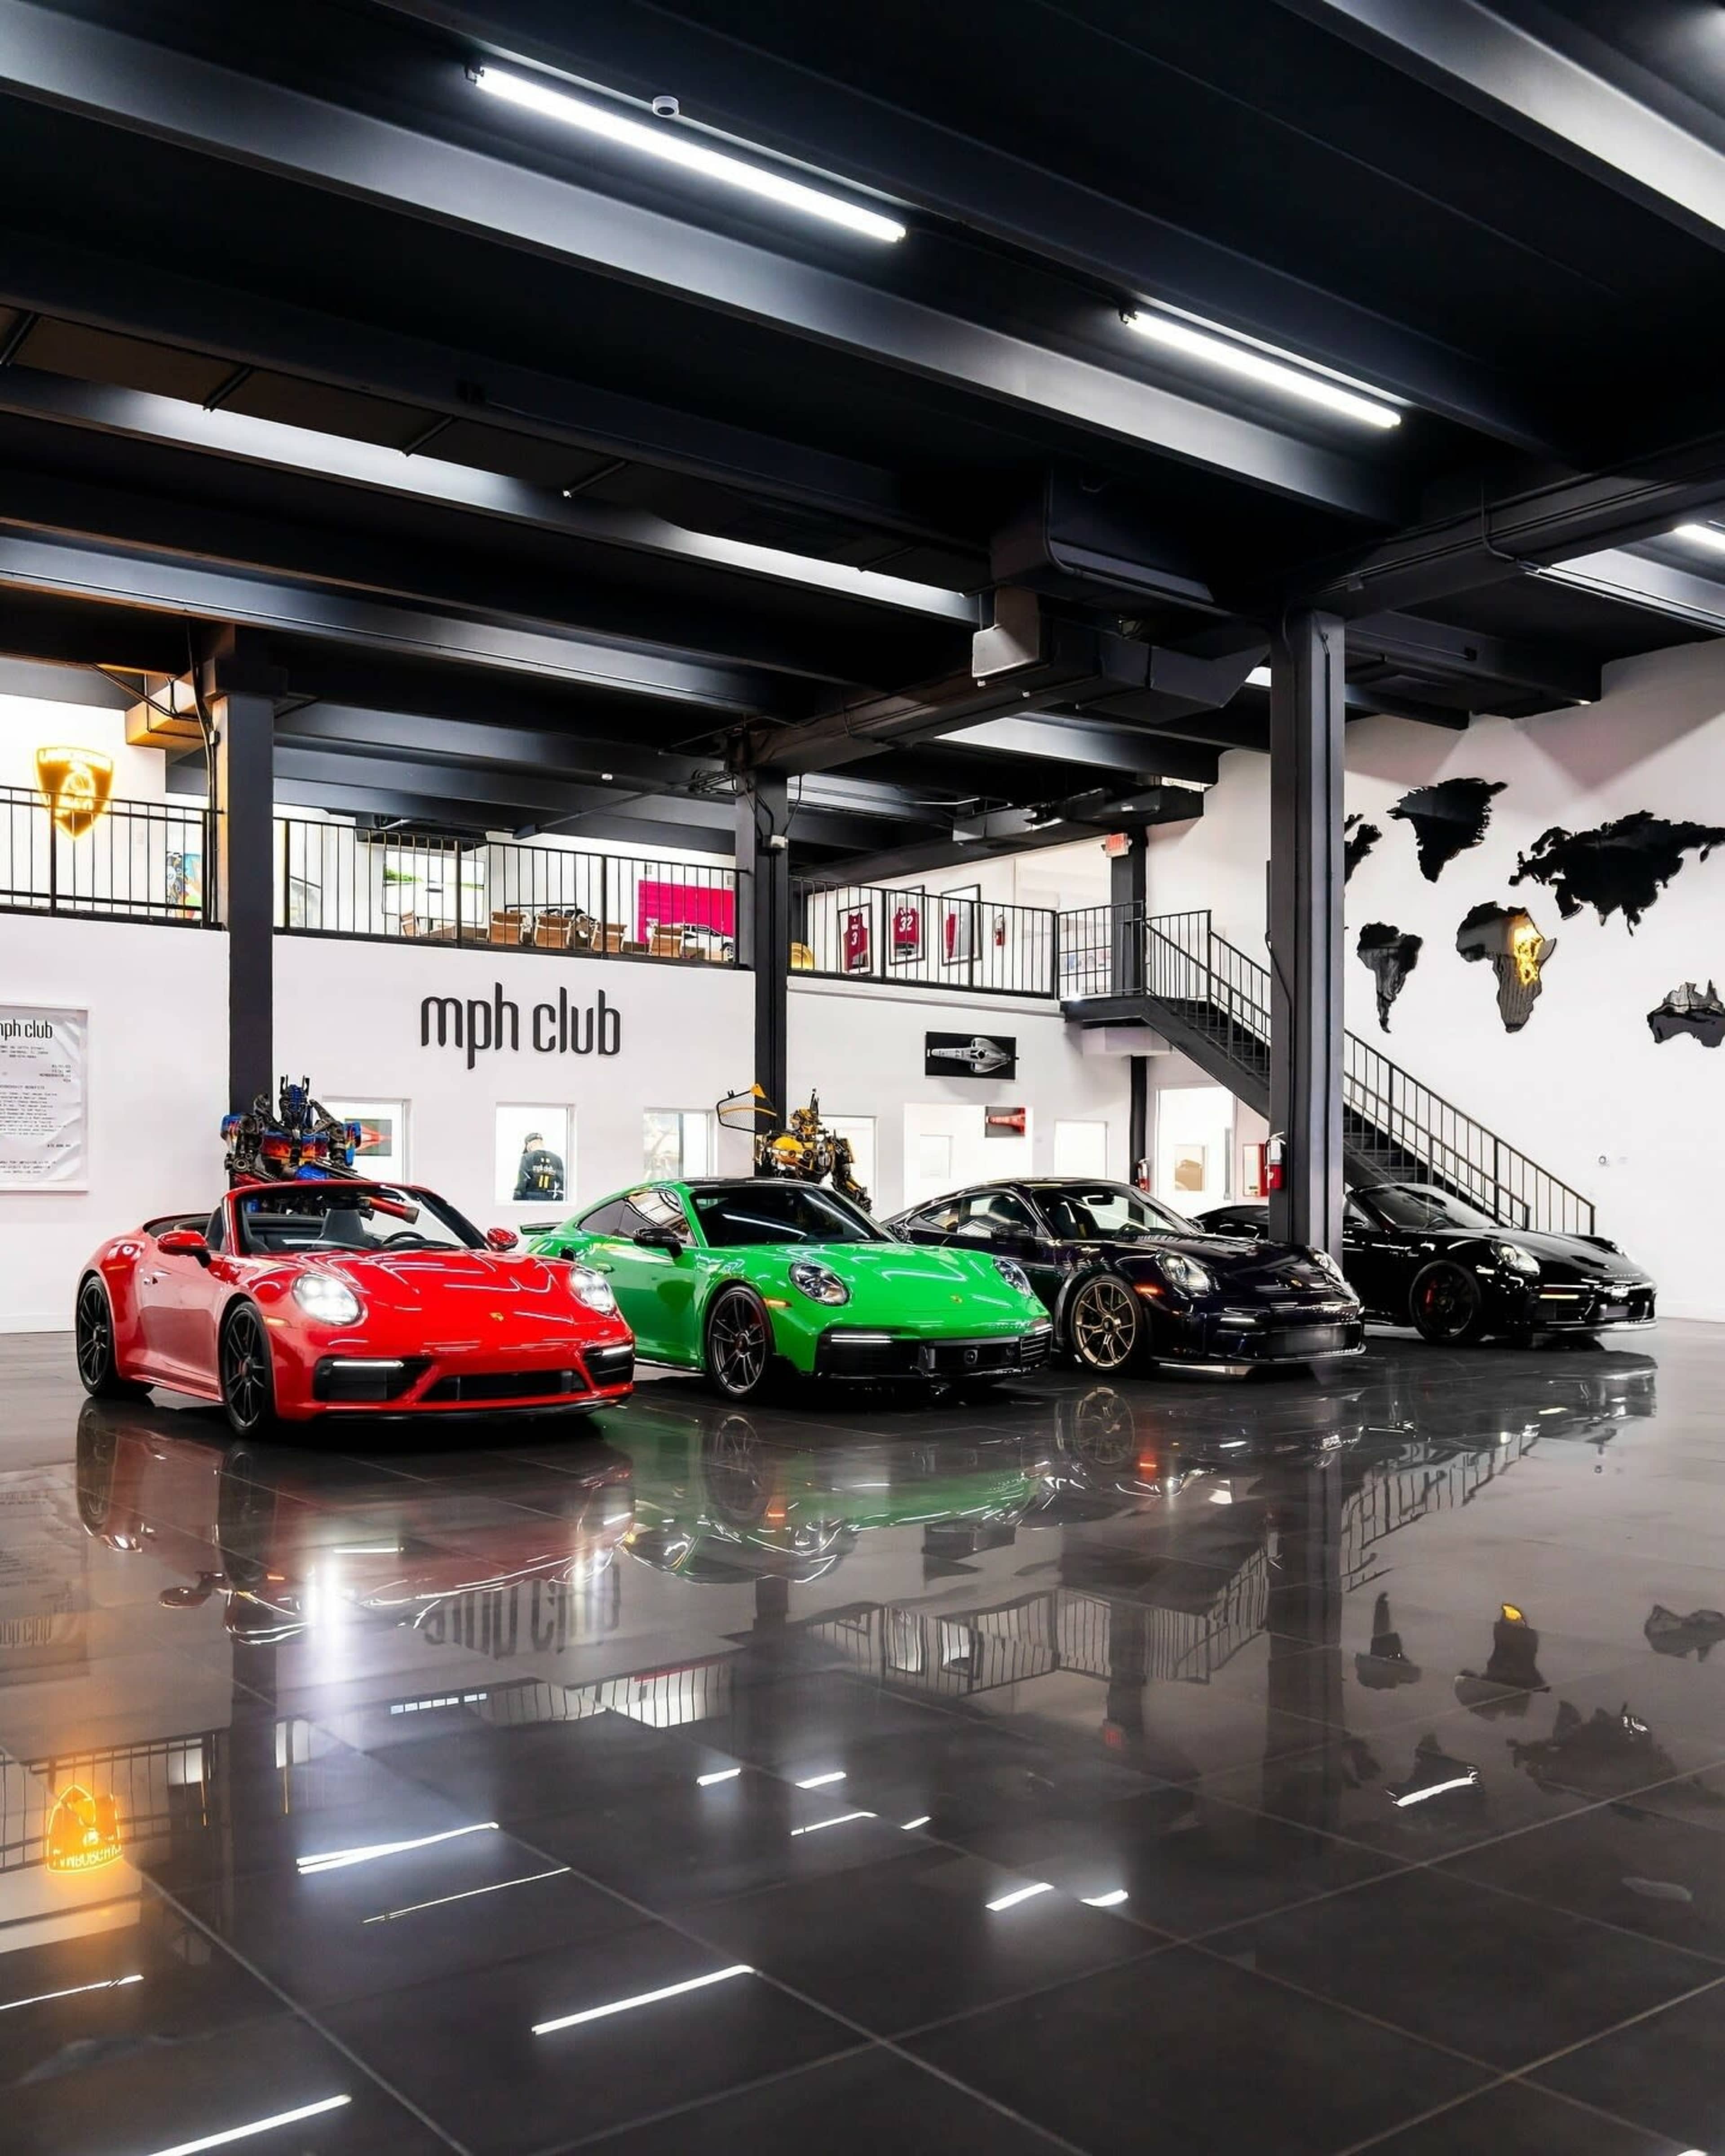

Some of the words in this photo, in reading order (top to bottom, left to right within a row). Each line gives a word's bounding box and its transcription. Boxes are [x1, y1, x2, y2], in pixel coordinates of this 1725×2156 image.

[899, 915, 913, 932] 32
[851, 931, 858, 945] 3
[25, 1020, 53, 1038] club
[421, 982, 518, 1069] mph
[533, 986, 620, 1056] club
